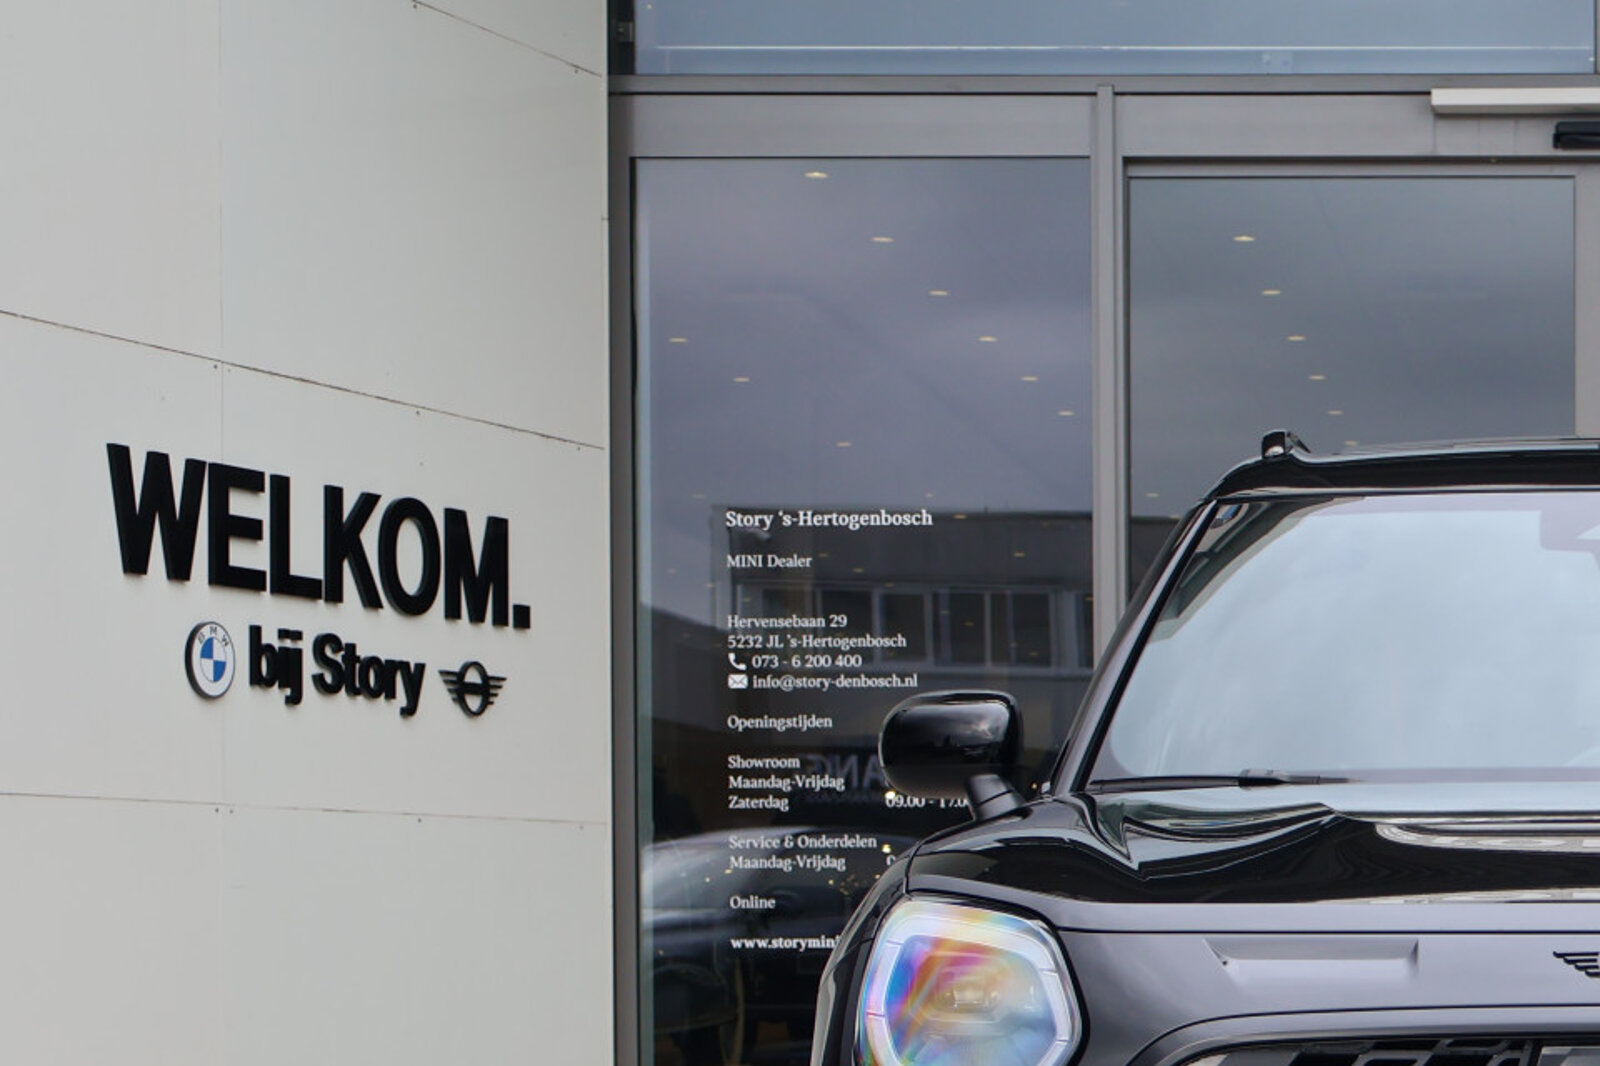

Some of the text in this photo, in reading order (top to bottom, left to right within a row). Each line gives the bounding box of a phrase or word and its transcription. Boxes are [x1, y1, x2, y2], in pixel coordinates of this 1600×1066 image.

[725, 510, 773, 531] Story
[106, 443, 530, 629] WELKOM.
[727, 554, 813, 567] MINI Dealer
[727, 615, 848, 628] Hervensebaan 29
[727, 635, 762, 648] 5232
[765, 635, 784, 648] JL
[752, 655, 778, 667] 073
[791, 655, 801, 667] 6
[805, 655, 831, 667] 200
[835, 655, 862, 667] 400
[249, 624, 425, 717] bij Story
[753, 674, 918, 691] info@story-denbosch.nl
[727, 715, 832, 732] Openingstijden
[728, 756, 800, 769] Showroom
[728, 775, 845, 791] Maandag-Vrijdag
[728, 796, 789, 811] Zaterdag
[940, 797, 968, 808] 17.0
[729, 834, 877, 848] Service & Onderdelen
[730, 855, 846, 872] Maandag-Vrijdag
[730, 896, 776, 909] Online
[731, 934, 840, 952] www.storymini
